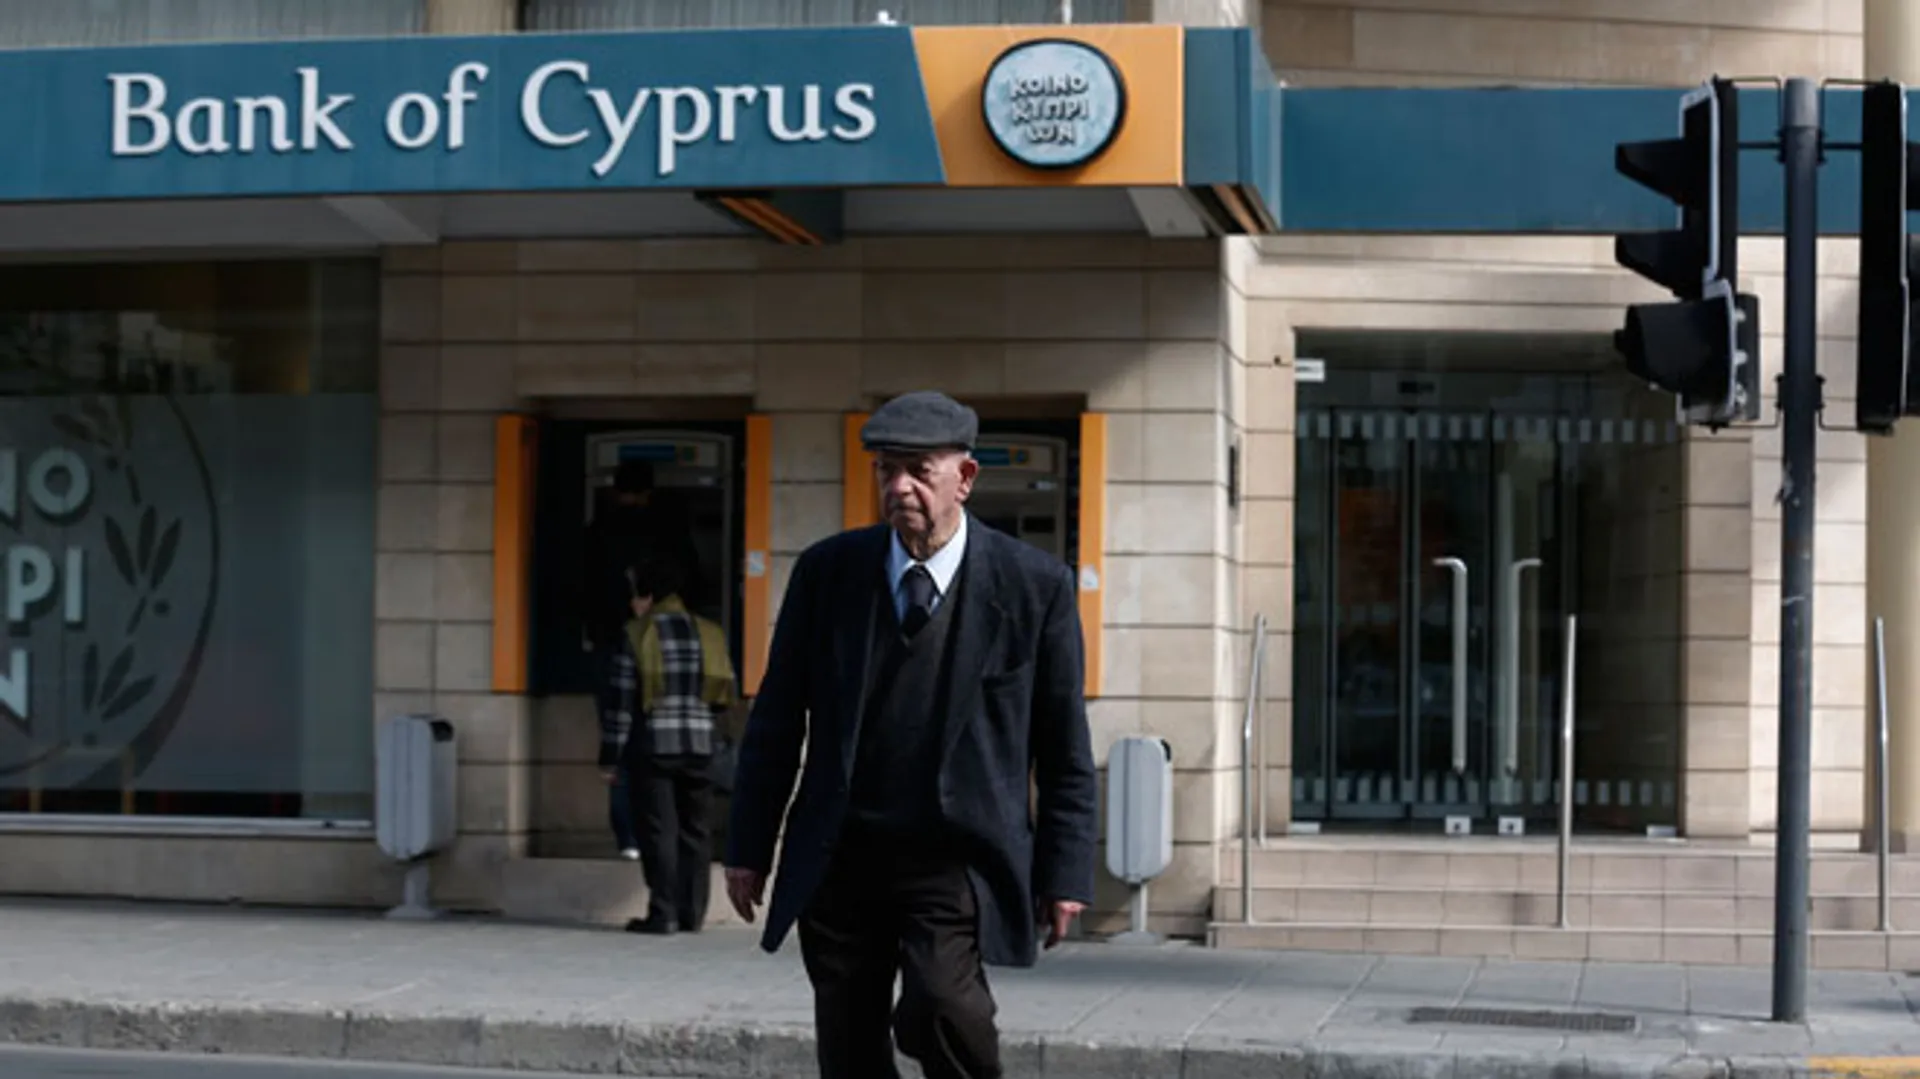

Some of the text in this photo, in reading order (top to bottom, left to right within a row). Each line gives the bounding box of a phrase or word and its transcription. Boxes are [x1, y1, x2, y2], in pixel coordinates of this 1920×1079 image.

[107, 59, 877, 177] Bank of Cyprus
